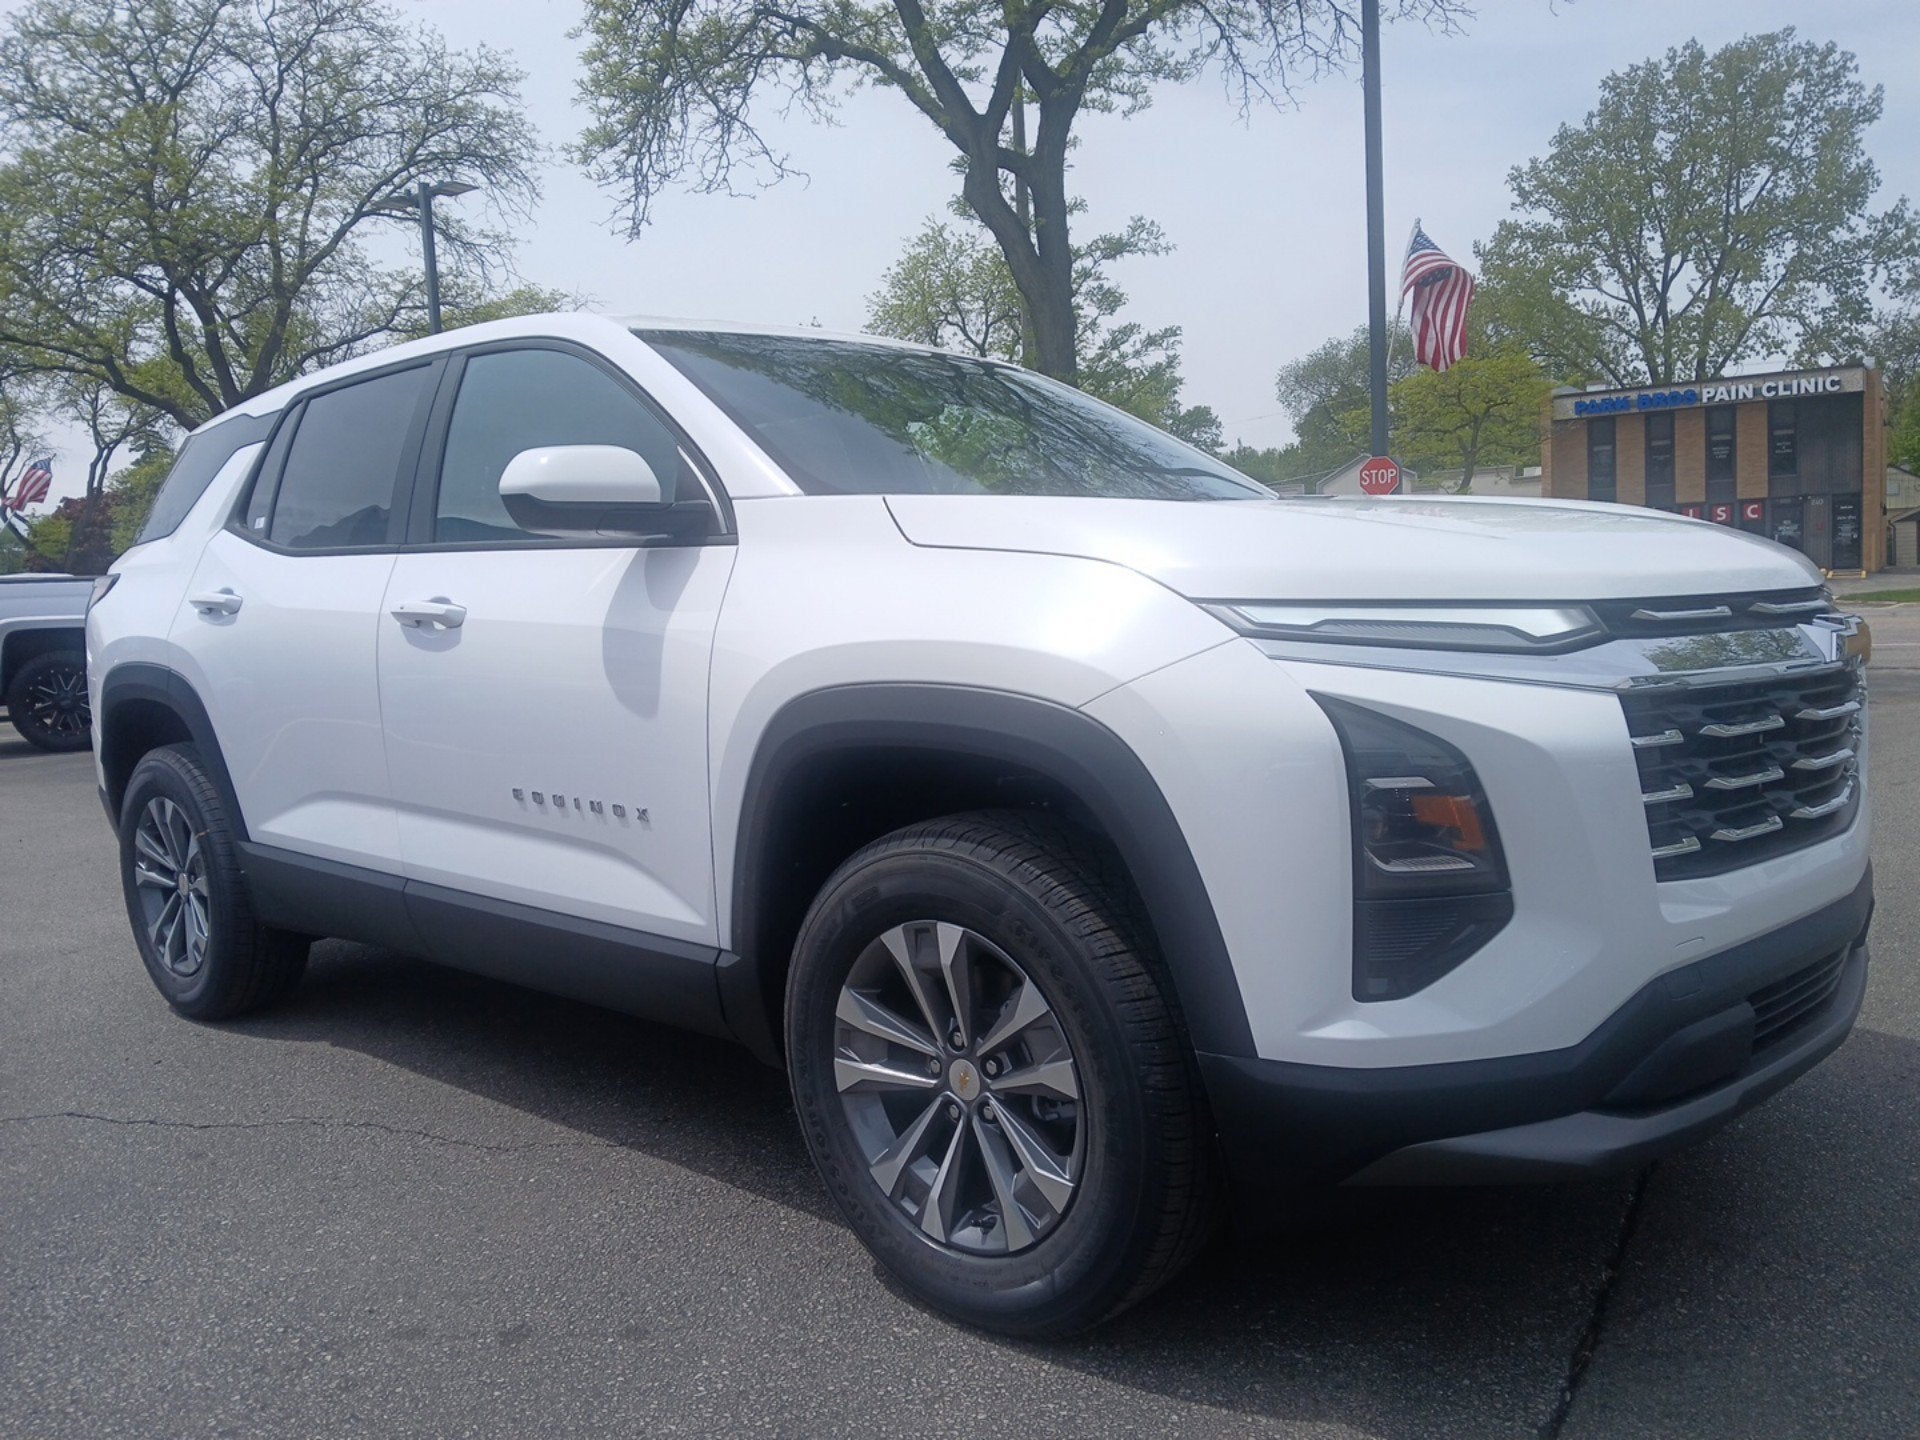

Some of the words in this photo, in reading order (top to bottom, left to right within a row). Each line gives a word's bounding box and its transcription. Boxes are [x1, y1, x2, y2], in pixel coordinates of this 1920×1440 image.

[1575, 395, 1631, 416] PARK
[1702, 383, 1754, 403] PAIN
[1761, 375, 1840, 398] CLINIC
[1361, 468, 1397, 485] STOP
[512, 788, 650, 823] EQUINOX
